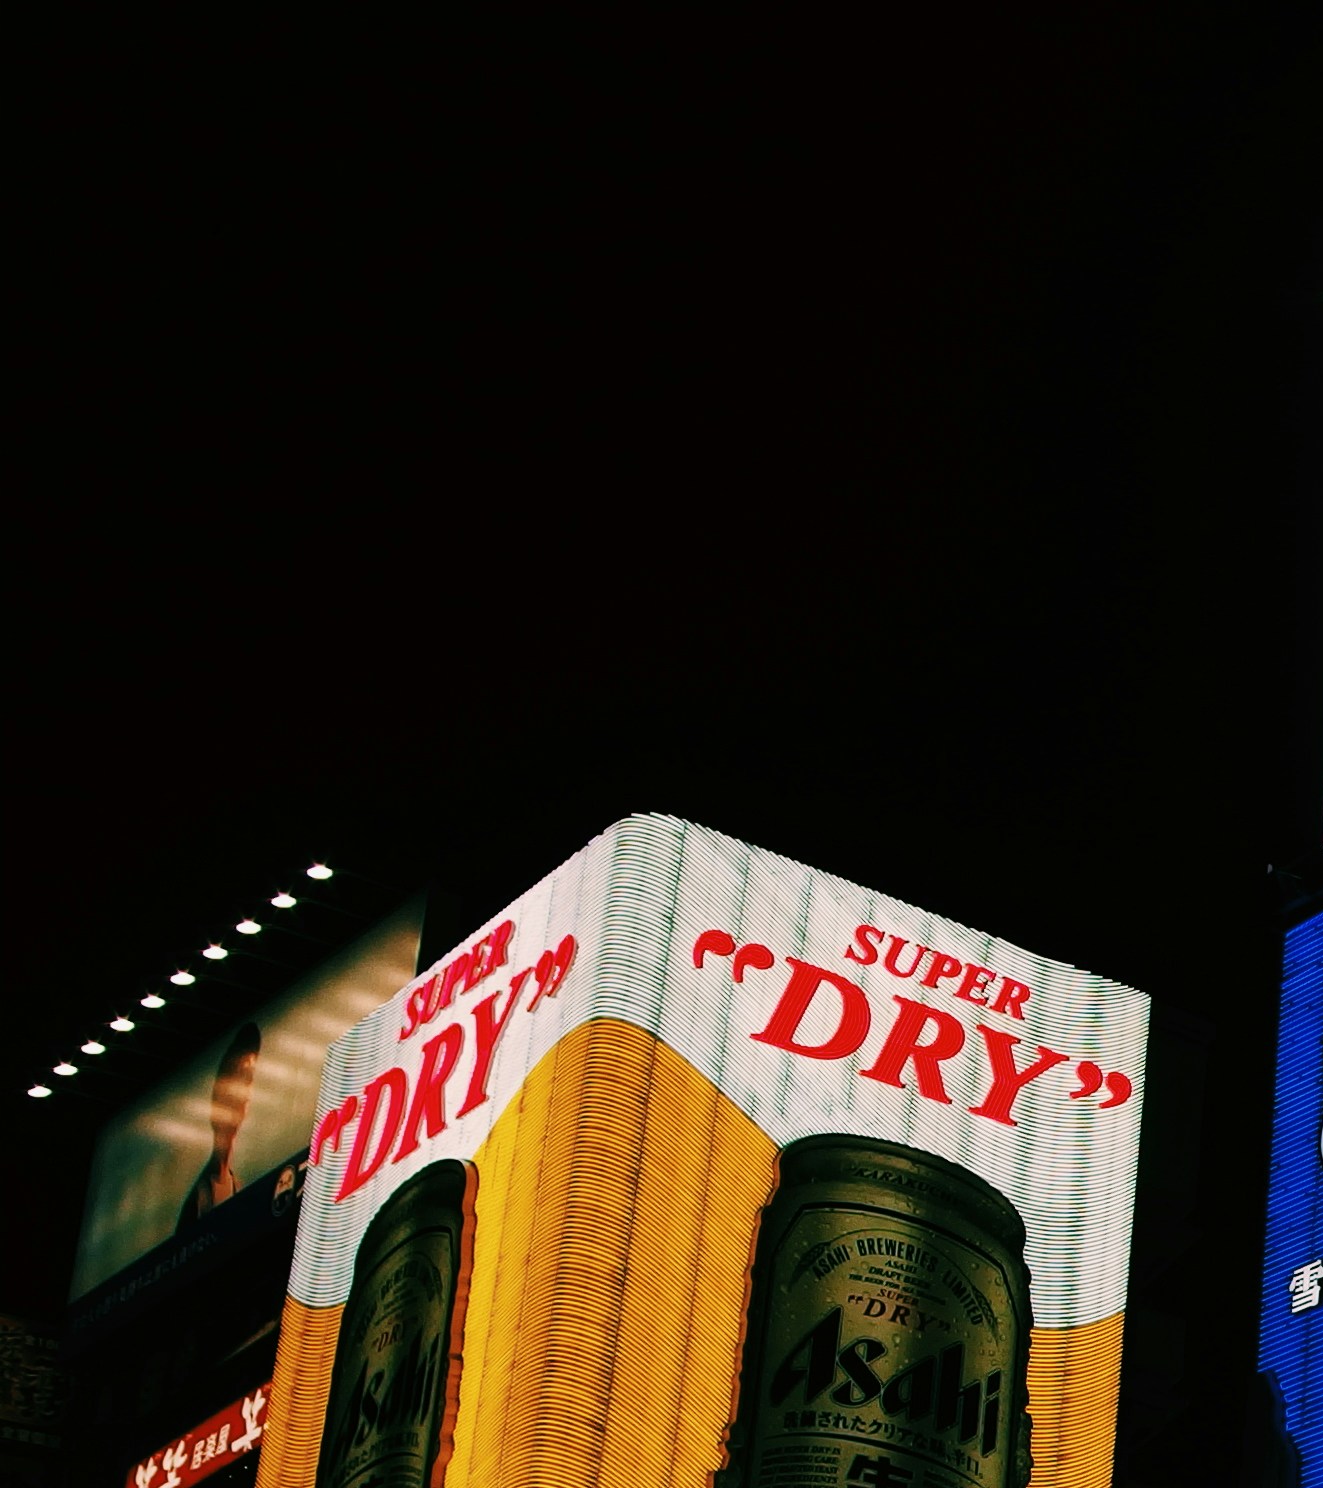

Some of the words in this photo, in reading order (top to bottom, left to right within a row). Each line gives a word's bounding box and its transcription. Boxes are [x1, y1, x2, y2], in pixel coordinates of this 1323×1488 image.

[397, 917, 515, 1045] SUPER
[844, 923, 1031, 1022] SUPER
[811, 1244, 851, 1282] ASAHI
[855, 1236, 939, 1273] BREWERIES
[942, 1269, 985, 1327] LIMITED
[769, 1304, 1002, 1460] Asahi
